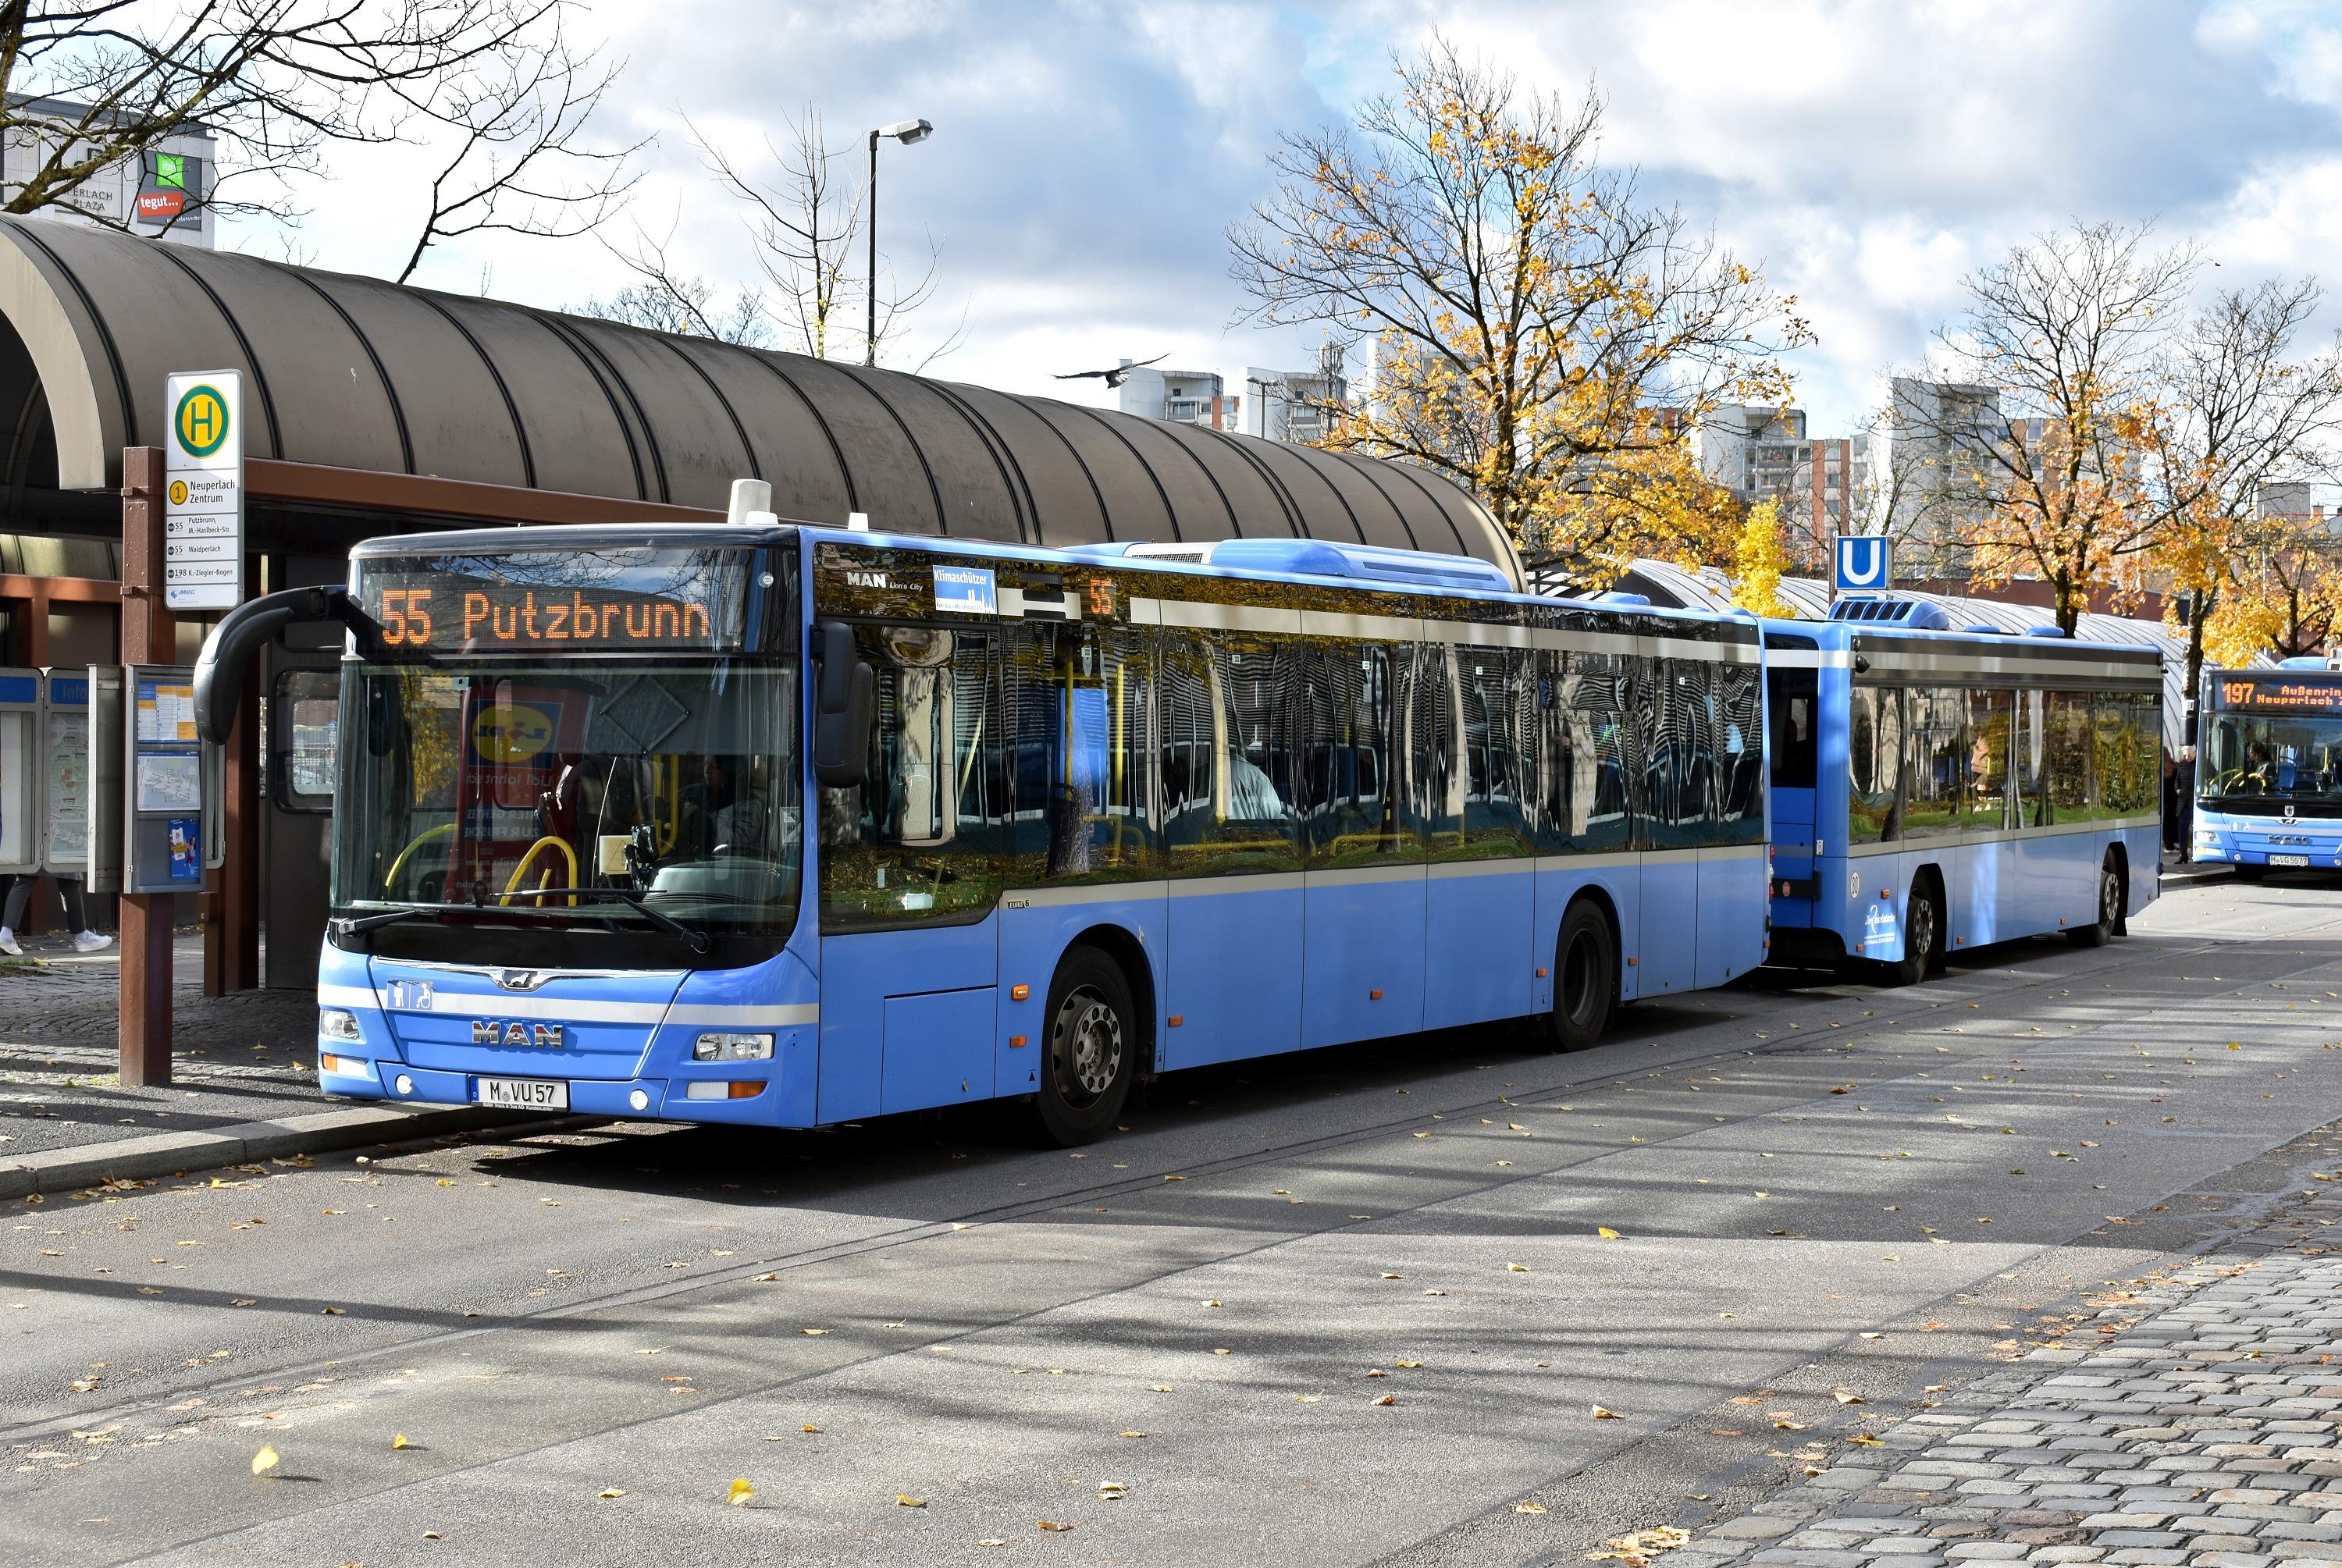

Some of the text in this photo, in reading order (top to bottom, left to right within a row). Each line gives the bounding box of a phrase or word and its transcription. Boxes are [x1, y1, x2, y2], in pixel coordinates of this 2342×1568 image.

[74, 199, 105, 211] PLAZA
[141, 196, 179, 210] tegut...
[190, 401, 212, 442] H
[175, 486, 182, 500] 1
[190, 479, 235, 492] Neuperlach
[190, 494, 223, 503] Zentrum
[1842, 540, 1881, 585] U
[188, 569, 233, 578] K.-Ziegler-Bogen
[847, 571, 924, 592] MAN Lion's City
[934, 569, 987, 585] Klimaschützer
[1091, 579, 1112, 616] 55
[382, 588, 710, 645] 55 Putzbrunn
[2223, 683, 2255, 704] 197
[2257, 694, 2333, 705] Neuperlach
[472, 1020, 566, 1048] MAN
[489, 1081, 500, 1100] M
[511, 1083, 531, 1102] VU
[536, 1084, 555, 1103] 57
